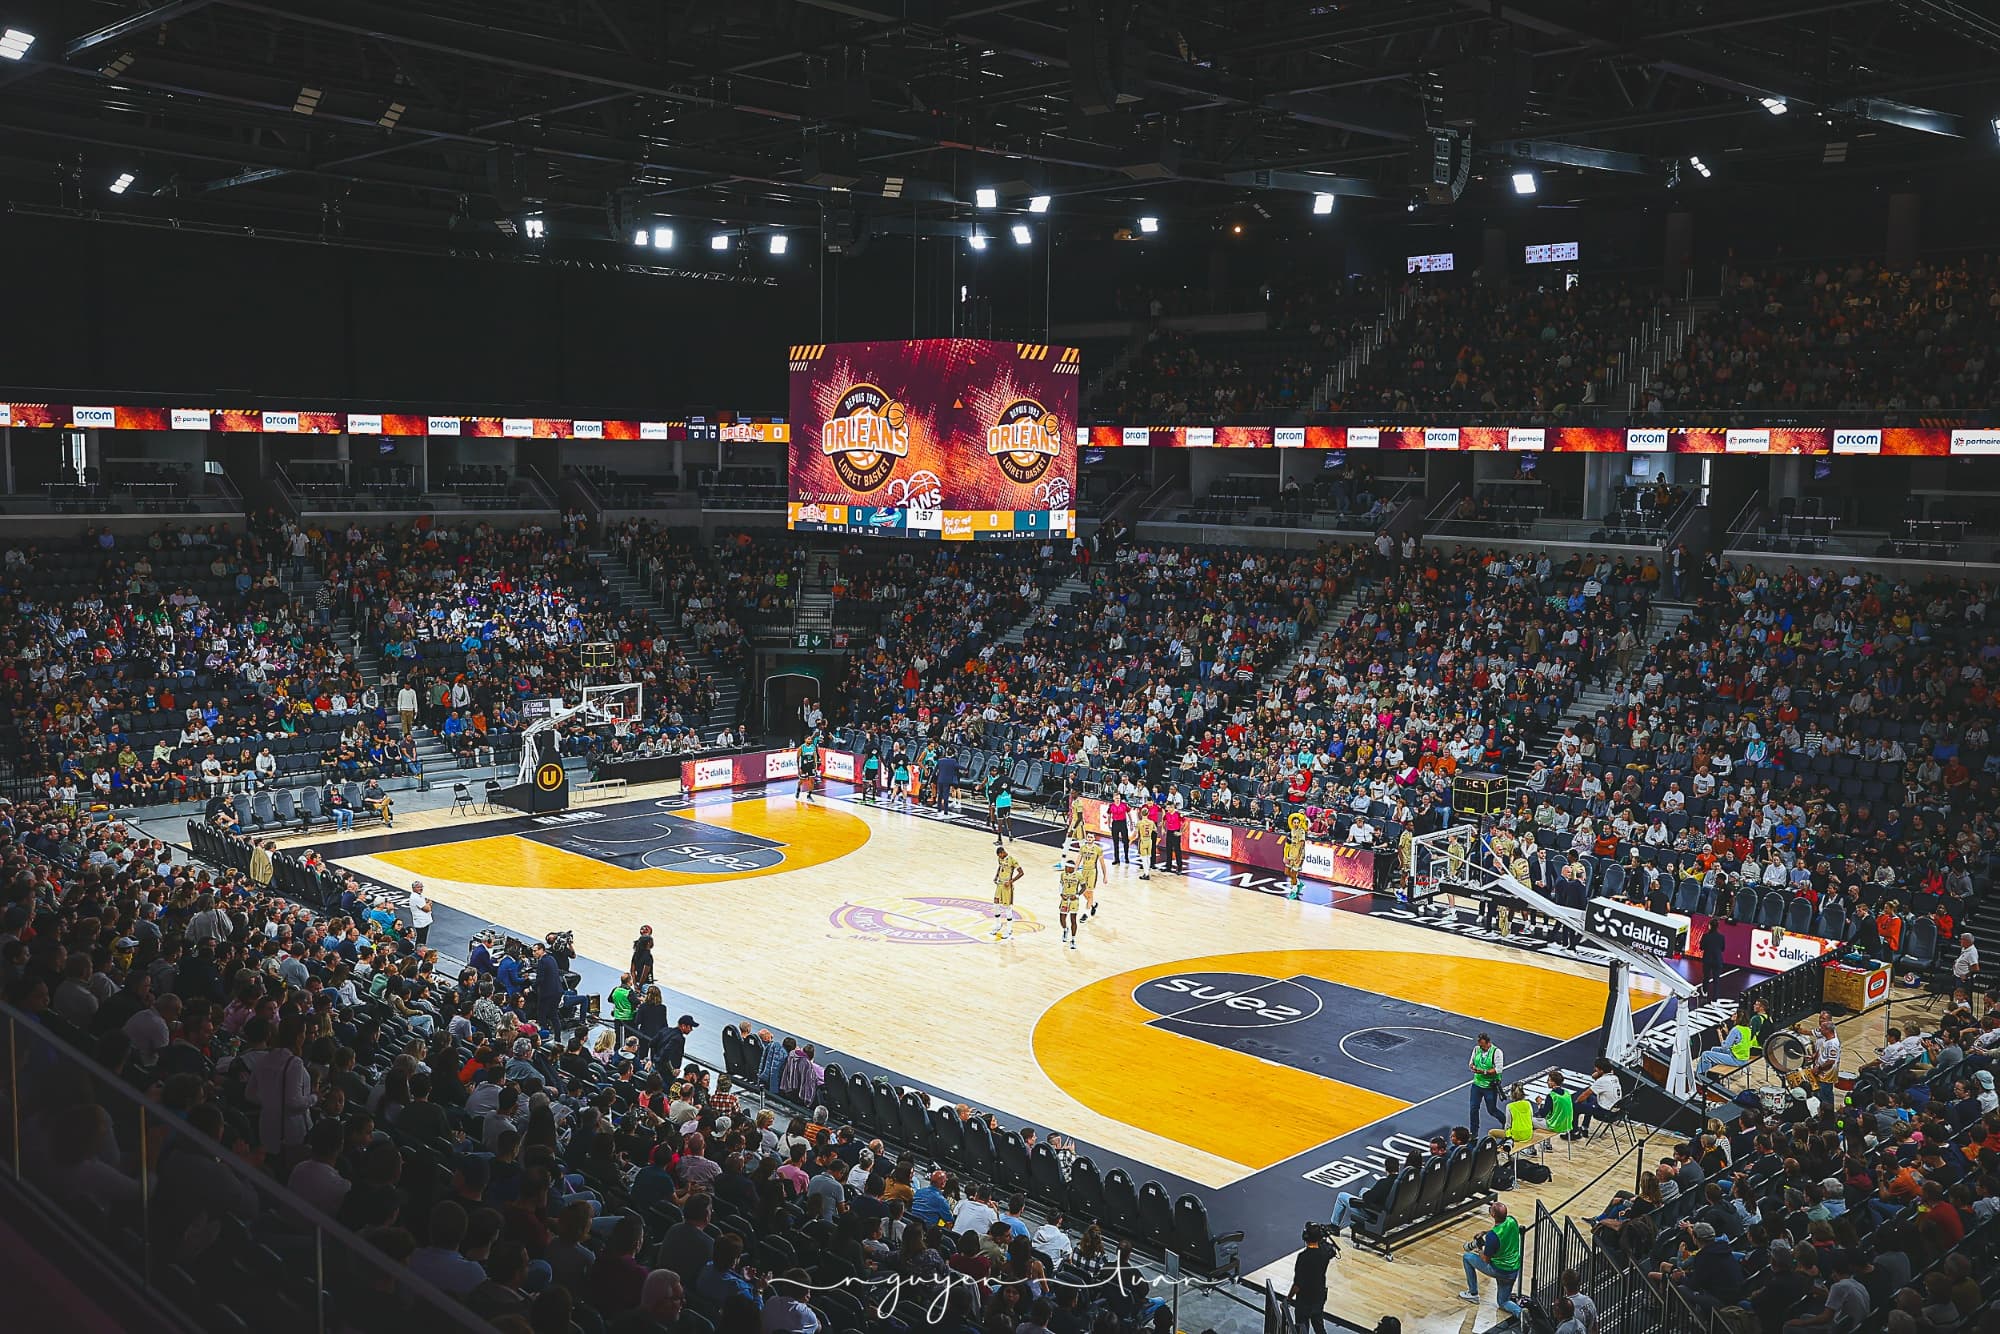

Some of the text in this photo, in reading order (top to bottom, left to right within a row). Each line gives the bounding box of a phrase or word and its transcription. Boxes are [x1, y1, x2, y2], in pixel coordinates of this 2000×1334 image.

[845, 392, 865, 410] DEPUIS
[76, 411, 112, 420] orcom
[1009, 404, 1027, 418] DEPUIS
[265, 416, 297, 425] orcom
[430, 420, 459, 429] orcom
[575, 424, 601, 433] orcom
[773, 427, 783, 439] 0
[1125, 432, 1147, 440] orcom
[1277, 432, 1303, 440] orcom
[1428, 433, 1457, 442] orcom
[1630, 434, 1665, 443] orcom
[1837, 434, 1878, 445] orcom
[1965, 438, 2000, 446] partnaire
[838, 457, 890, 487] LOIRET BASKET
[1002, 455, 1047, 479] LOIRET BASKET
[909, 488, 942, 510] ANS
[1050, 489, 1070, 508] ANS
[833, 507, 840, 520] 0
[855, 509, 862, 521] 0
[915, 510, 934, 521] 1:57
[990, 513, 997, 526] 0
[1029, 513, 1036, 526] 0
[837, 761, 853, 772] dalkia
[543, 771, 556, 785] U
[710, 768, 731, 779] dalkia
[1206, 832, 1230, 847] dalkia
[667, 845, 760, 870] suez
[1306, 853, 1331, 867] dalkia
[1622, 922, 1669, 948] dalkia
[1154, 979, 1302, 1021] suez
[1309, 1164, 1361, 1185] COM
